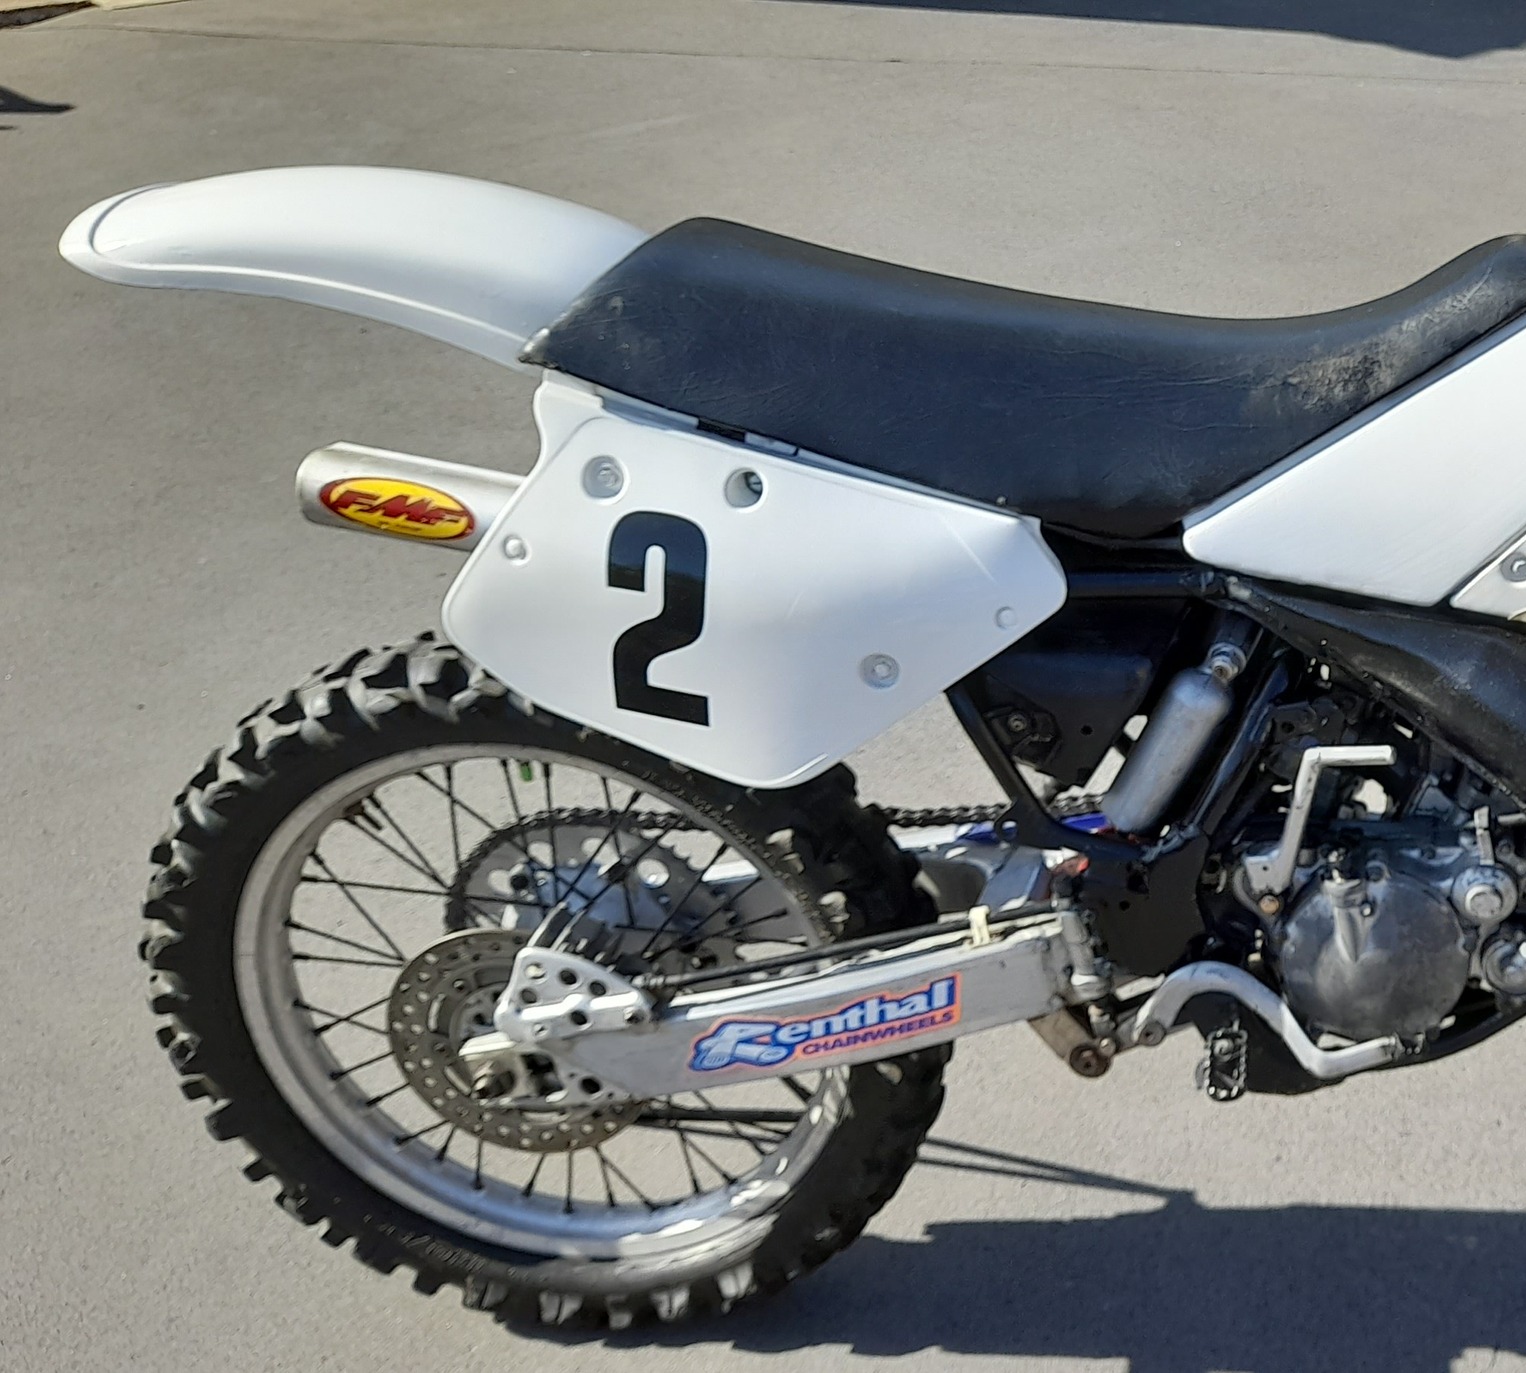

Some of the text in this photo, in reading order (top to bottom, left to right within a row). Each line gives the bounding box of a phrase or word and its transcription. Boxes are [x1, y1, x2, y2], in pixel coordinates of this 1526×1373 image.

[331, 489, 469, 526] FMF
[608, 511, 709, 727] 2
[689, 974, 957, 1071] Renthal
[802, 1010, 955, 1056] CHAINWHEELS
